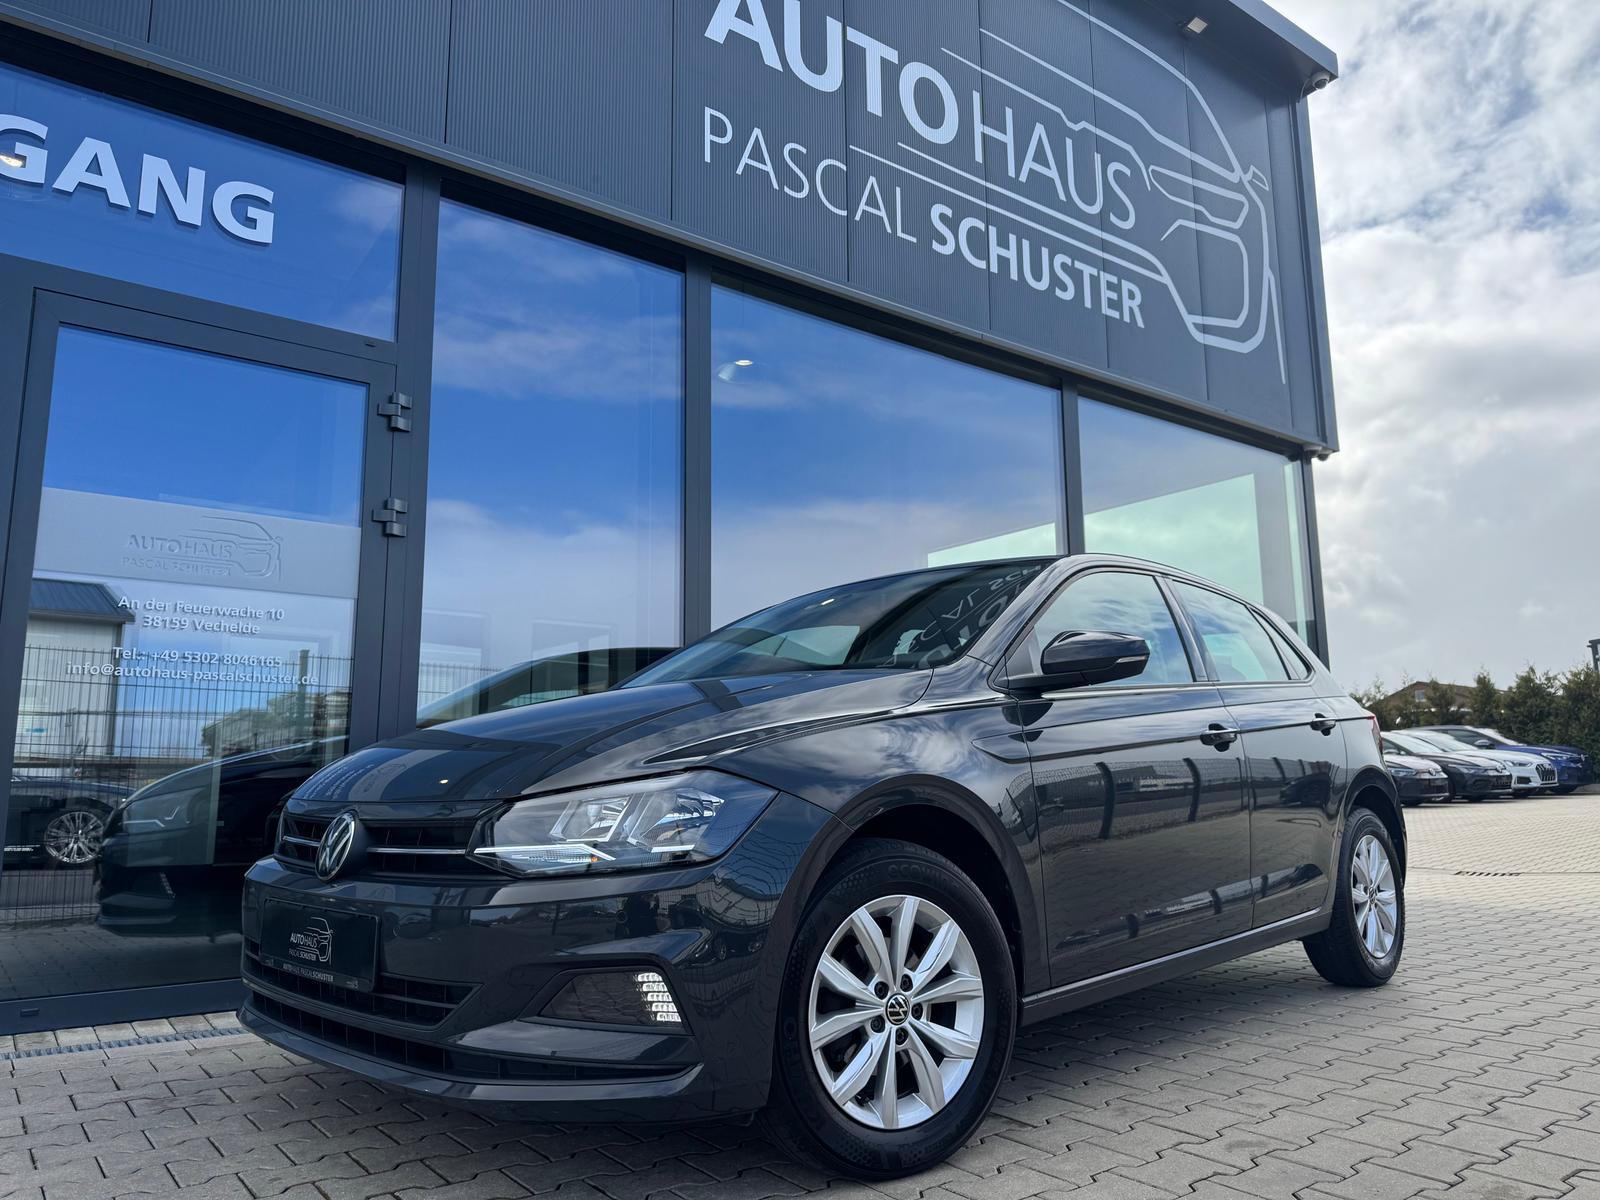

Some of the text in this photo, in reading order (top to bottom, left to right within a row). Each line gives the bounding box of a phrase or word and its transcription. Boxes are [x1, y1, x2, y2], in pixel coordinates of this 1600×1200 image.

[704, 0, 1136, 230] AUTOHAUS
[0, 114, 274, 244] GANG
[703, 106, 1145, 329] PASCAL SCHUSTER
[126, 534, 232, 560] AUTOHAUS
[122, 556, 168, 571] PASCAL
[118, 596, 285, 621] An der Feuerwache 10
[143, 615, 260, 635] 38159 Vechelde
[152, 650, 179, 663] +49
[183, 651, 219, 664] 5302
[66, 662, 319, 686] info@autohaus-pascalschuster.de
[289, 932, 318, 948] AUTOHAUS
